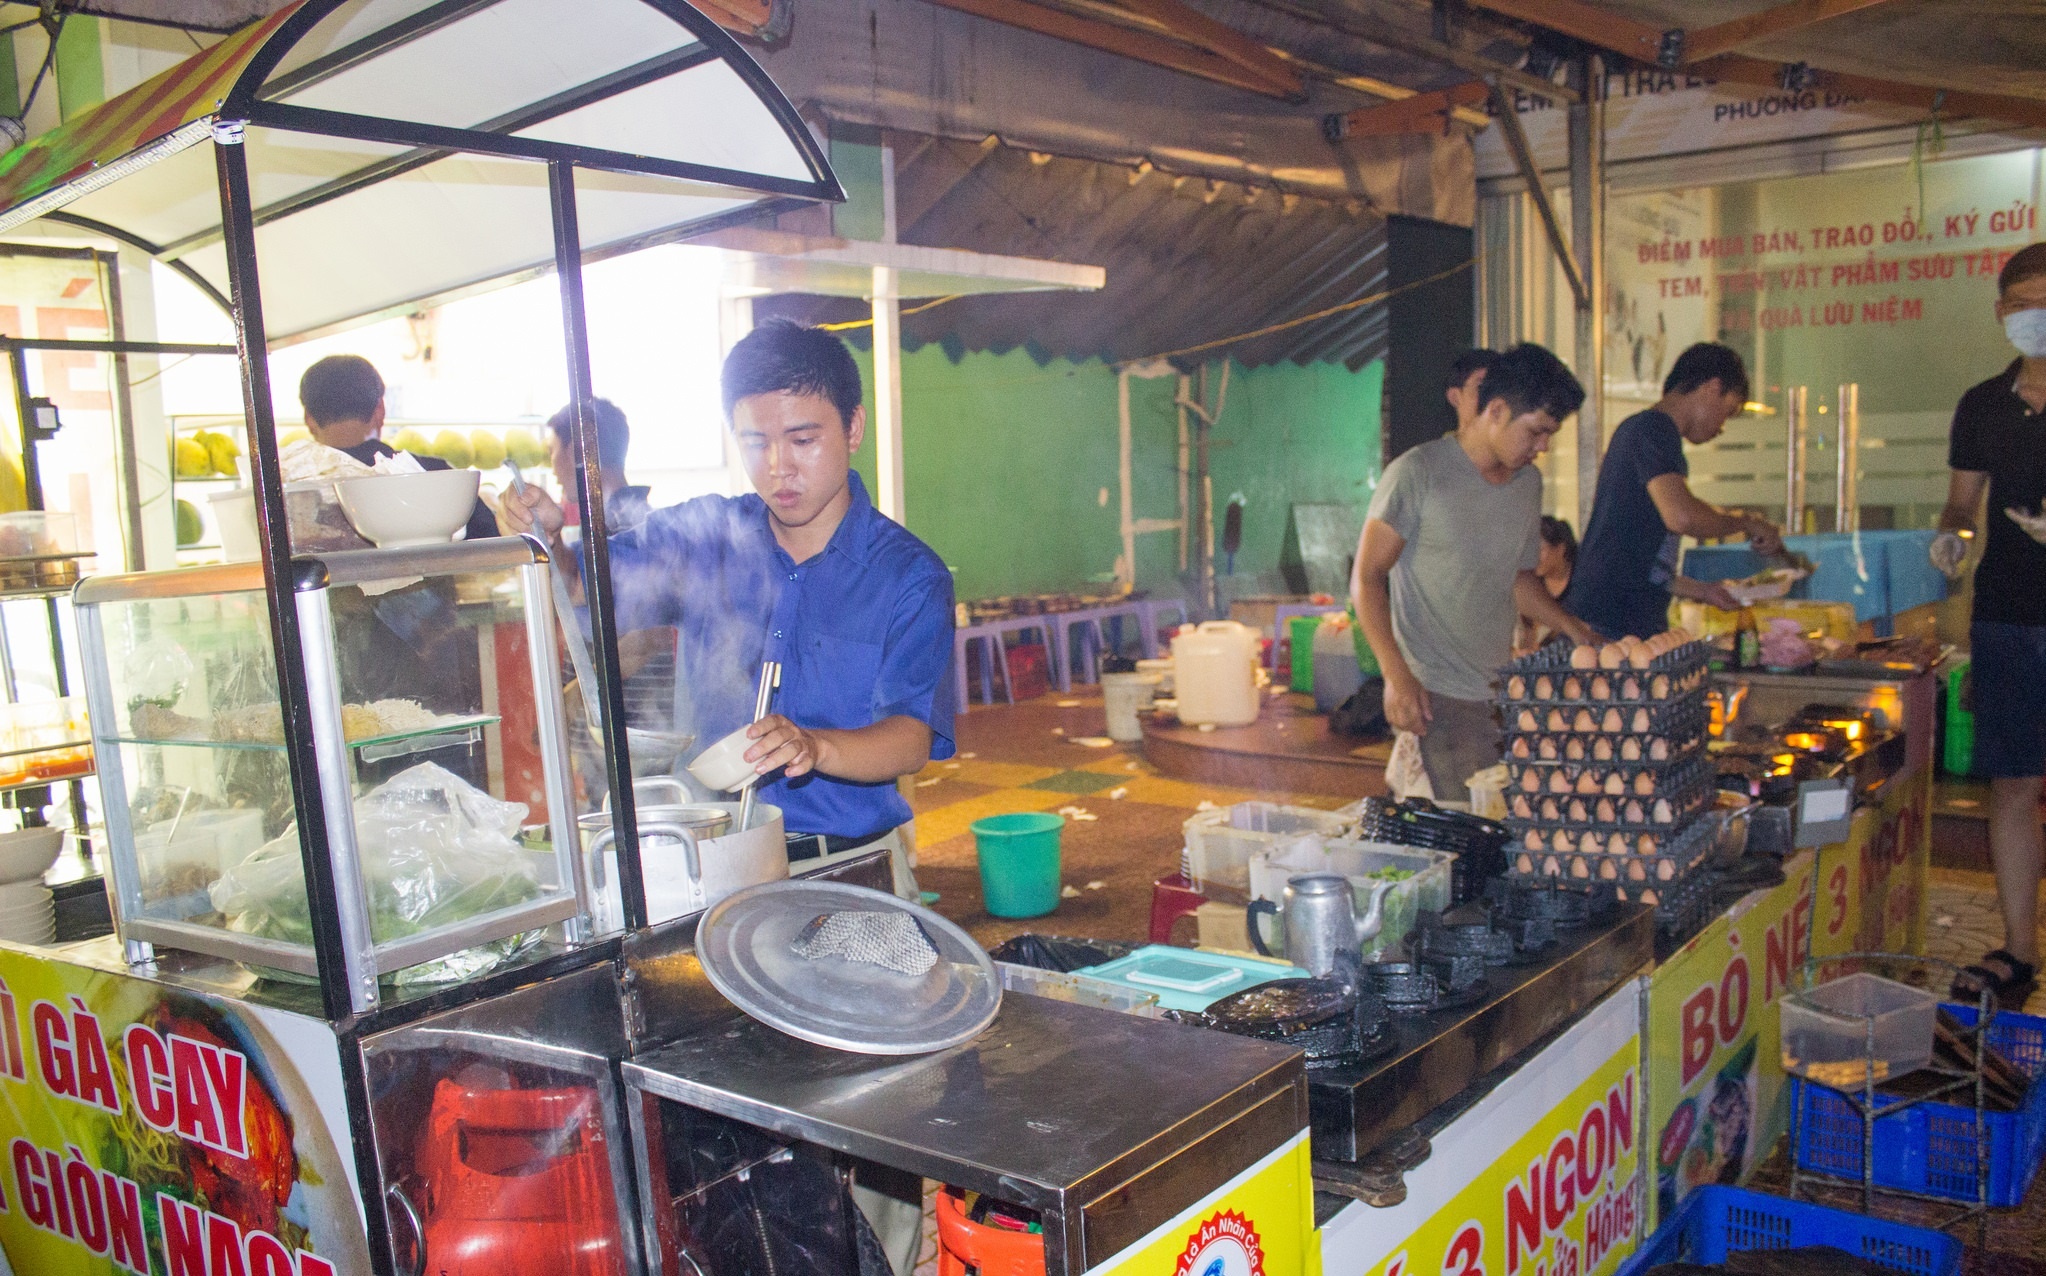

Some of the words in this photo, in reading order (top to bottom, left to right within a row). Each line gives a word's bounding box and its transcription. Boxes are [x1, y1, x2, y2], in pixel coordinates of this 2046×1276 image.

[1659, 277, 1710, 299] TEM,
[1907, 254, 1955, 281] SƯU
[1699, 236, 1745, 259] MUA
[1811, 223, 1874, 249] TRAO
[1945, 207, 1979, 238] KÝ
[1989, 200, 2035, 234] GỬI
[1809, 299, 1854, 327] LƯU
[1861, 295, 1923, 327] NIỆM
[1682, 932, 1749, 1088] BÒ
[1828, 865, 1848, 936] 3
[33, 996, 119, 1111] GÀ
[127, 1027, 244, 1155] CAY
[12, 1139, 149, 1276] GIÒN
[1507, 1072, 1633, 1276] NGON
[1183, 1242, 1200, 1265] Là
[1201, 1226, 1216, 1246] Ân
[1219, 1217, 1246, 1240] Nhân
[1244, 1233, 1259, 1269] Của
[1585, 1177, 1637, 1273] Hồng
